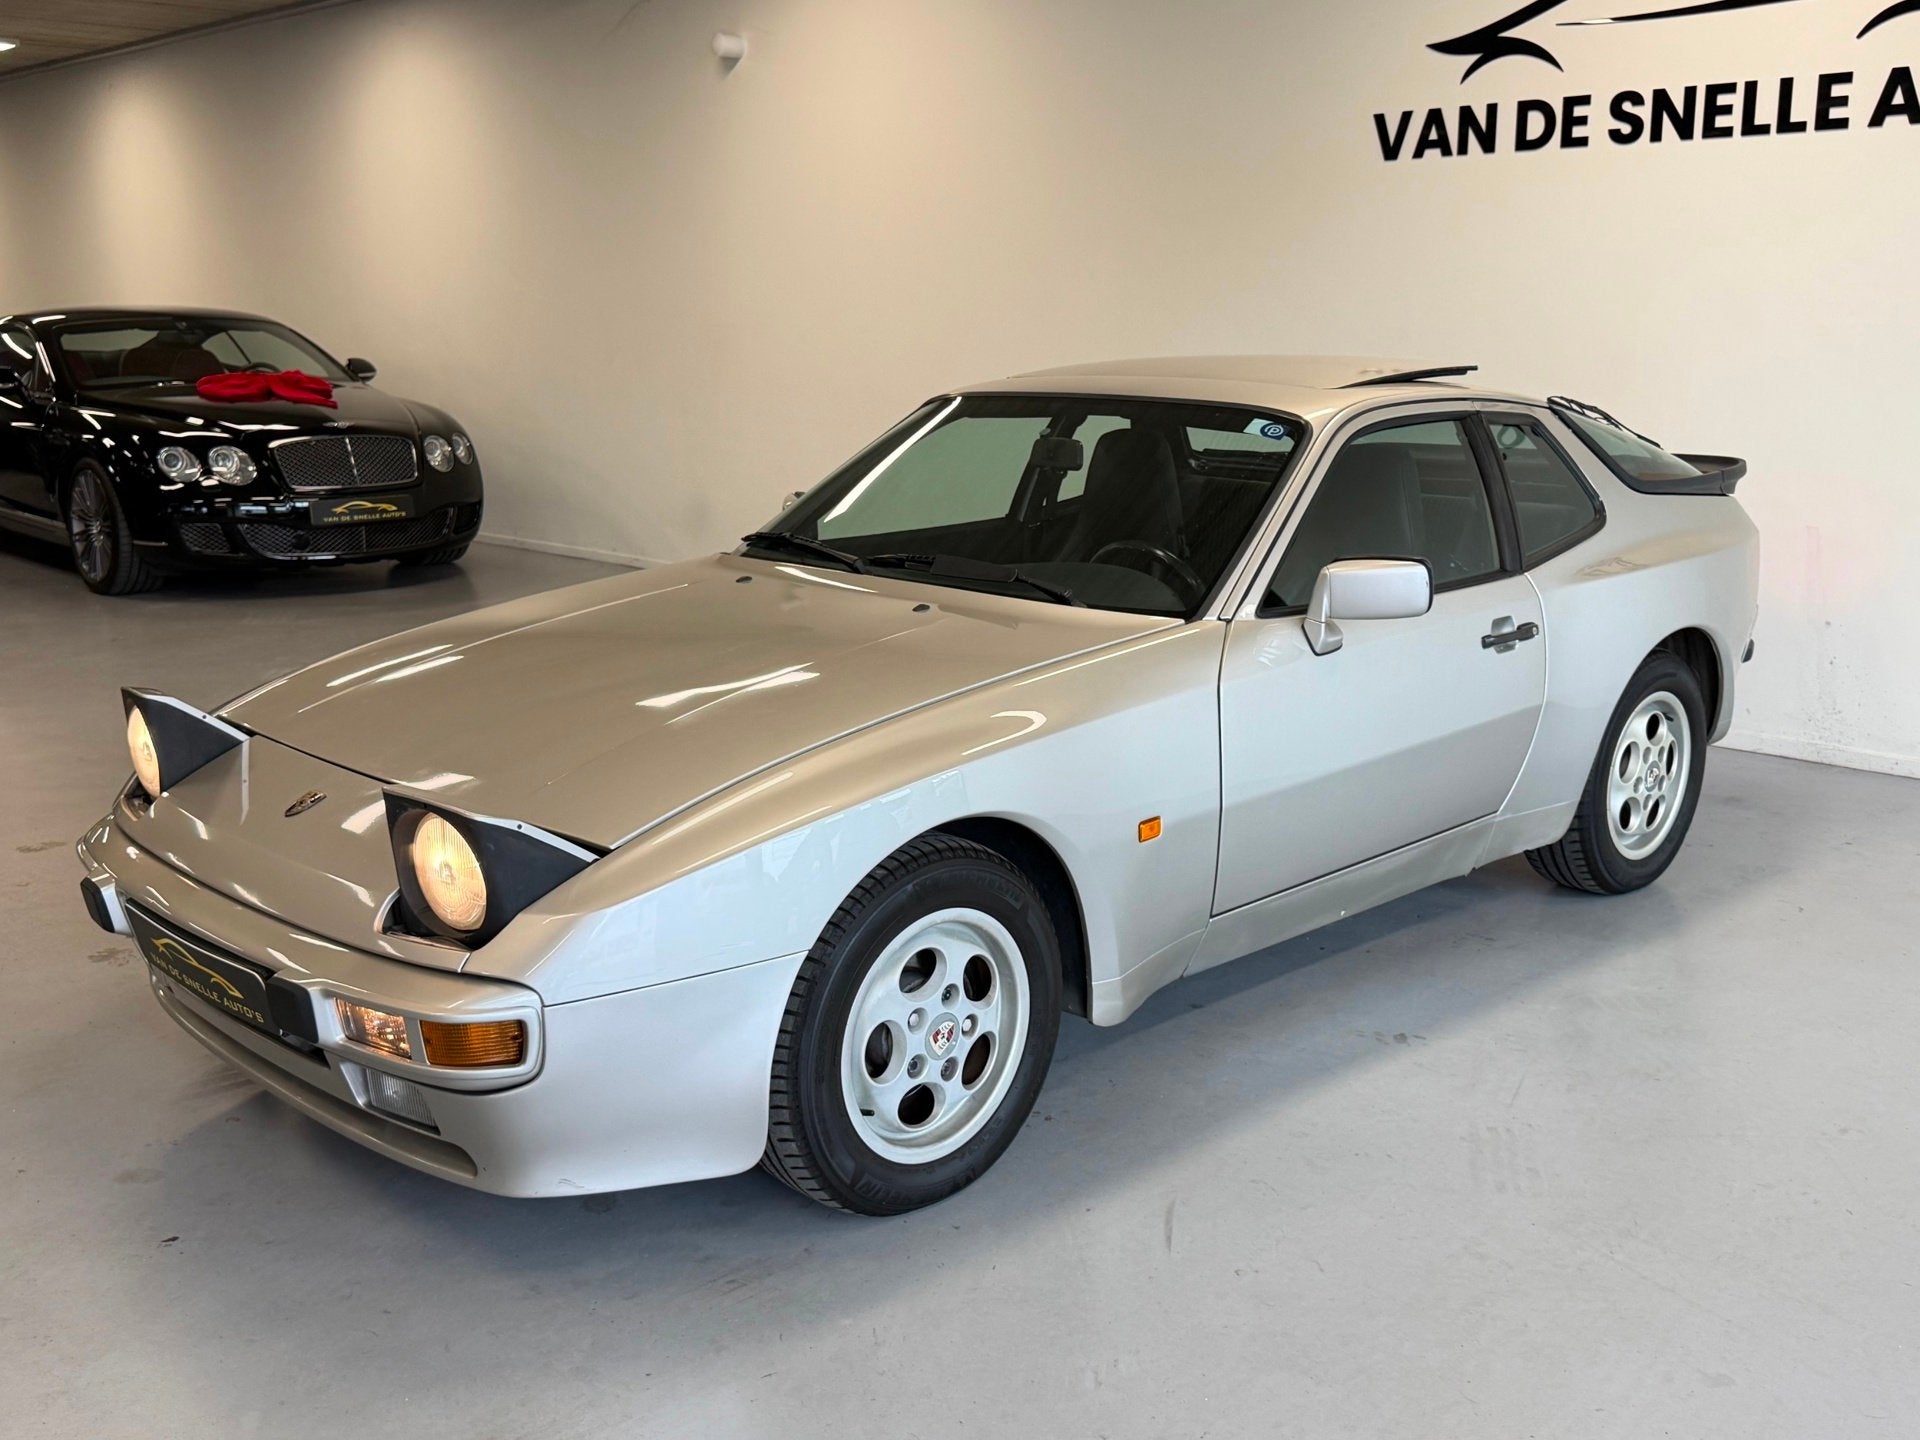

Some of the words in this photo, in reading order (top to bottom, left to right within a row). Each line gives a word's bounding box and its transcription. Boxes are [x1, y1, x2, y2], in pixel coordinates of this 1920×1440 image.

[1373, 102, 1498, 161] VAN
[1514, 94, 1592, 152] DE
[1607, 71, 1854, 145] SNELLE
[152, 953, 168, 970] VAN
[170, 965, 182, 981] DE
[183, 974, 222, 1004] SNELLE
[223, 996, 265, 1024] AUTO'S
